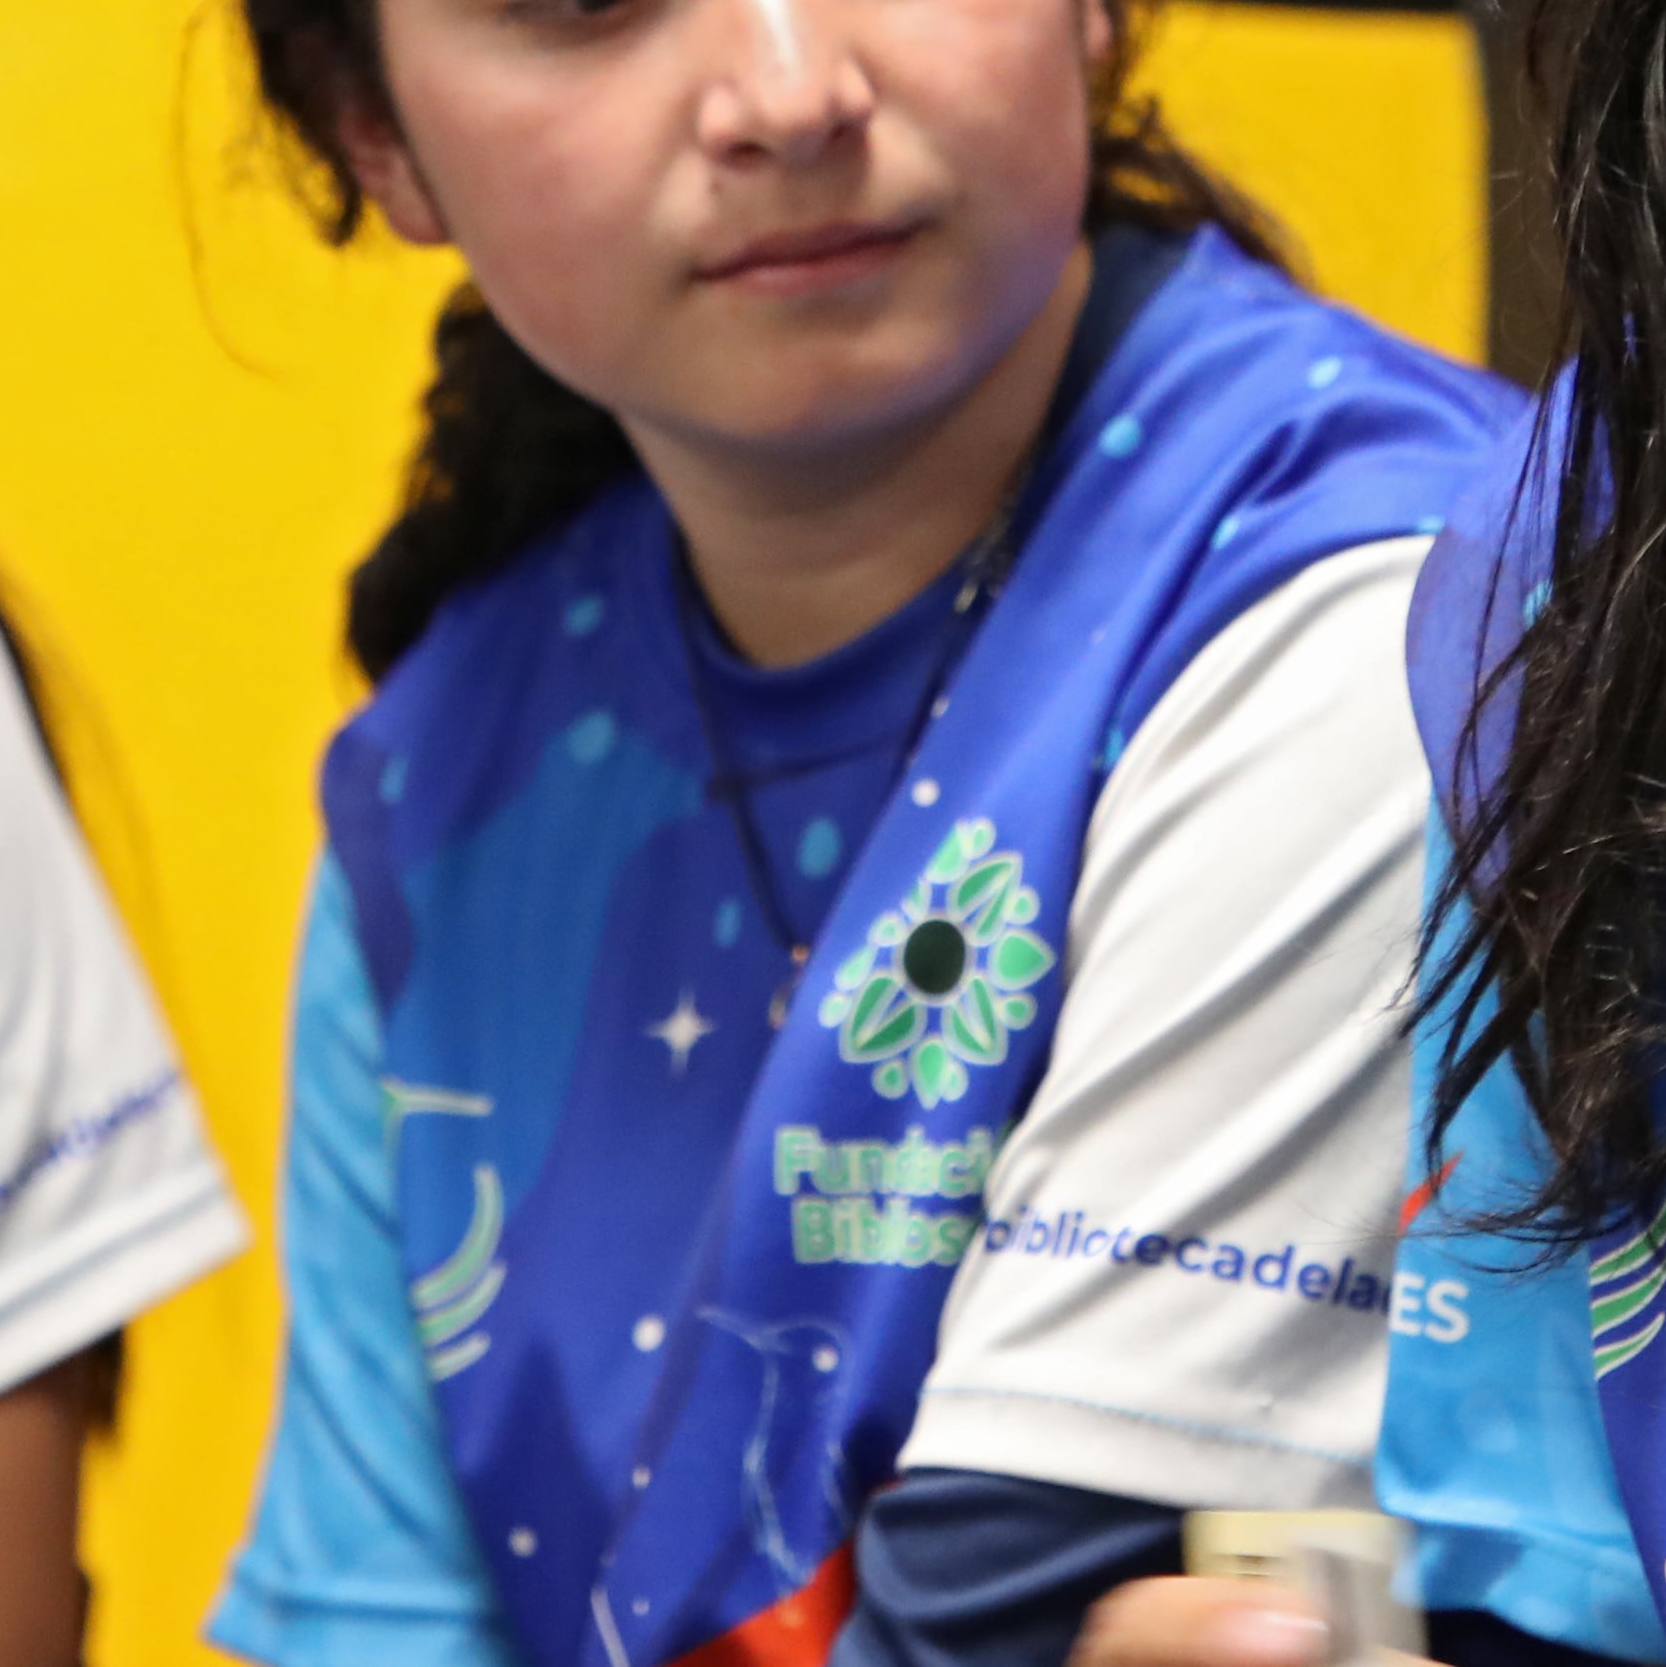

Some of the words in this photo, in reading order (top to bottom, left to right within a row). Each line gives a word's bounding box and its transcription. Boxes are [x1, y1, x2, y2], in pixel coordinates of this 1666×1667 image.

[774, 1124, 997, 1198] Fundaci
[791, 1196, 979, 1268] Biblos
[983, 1204, 1392, 1317] bibliotecadela
